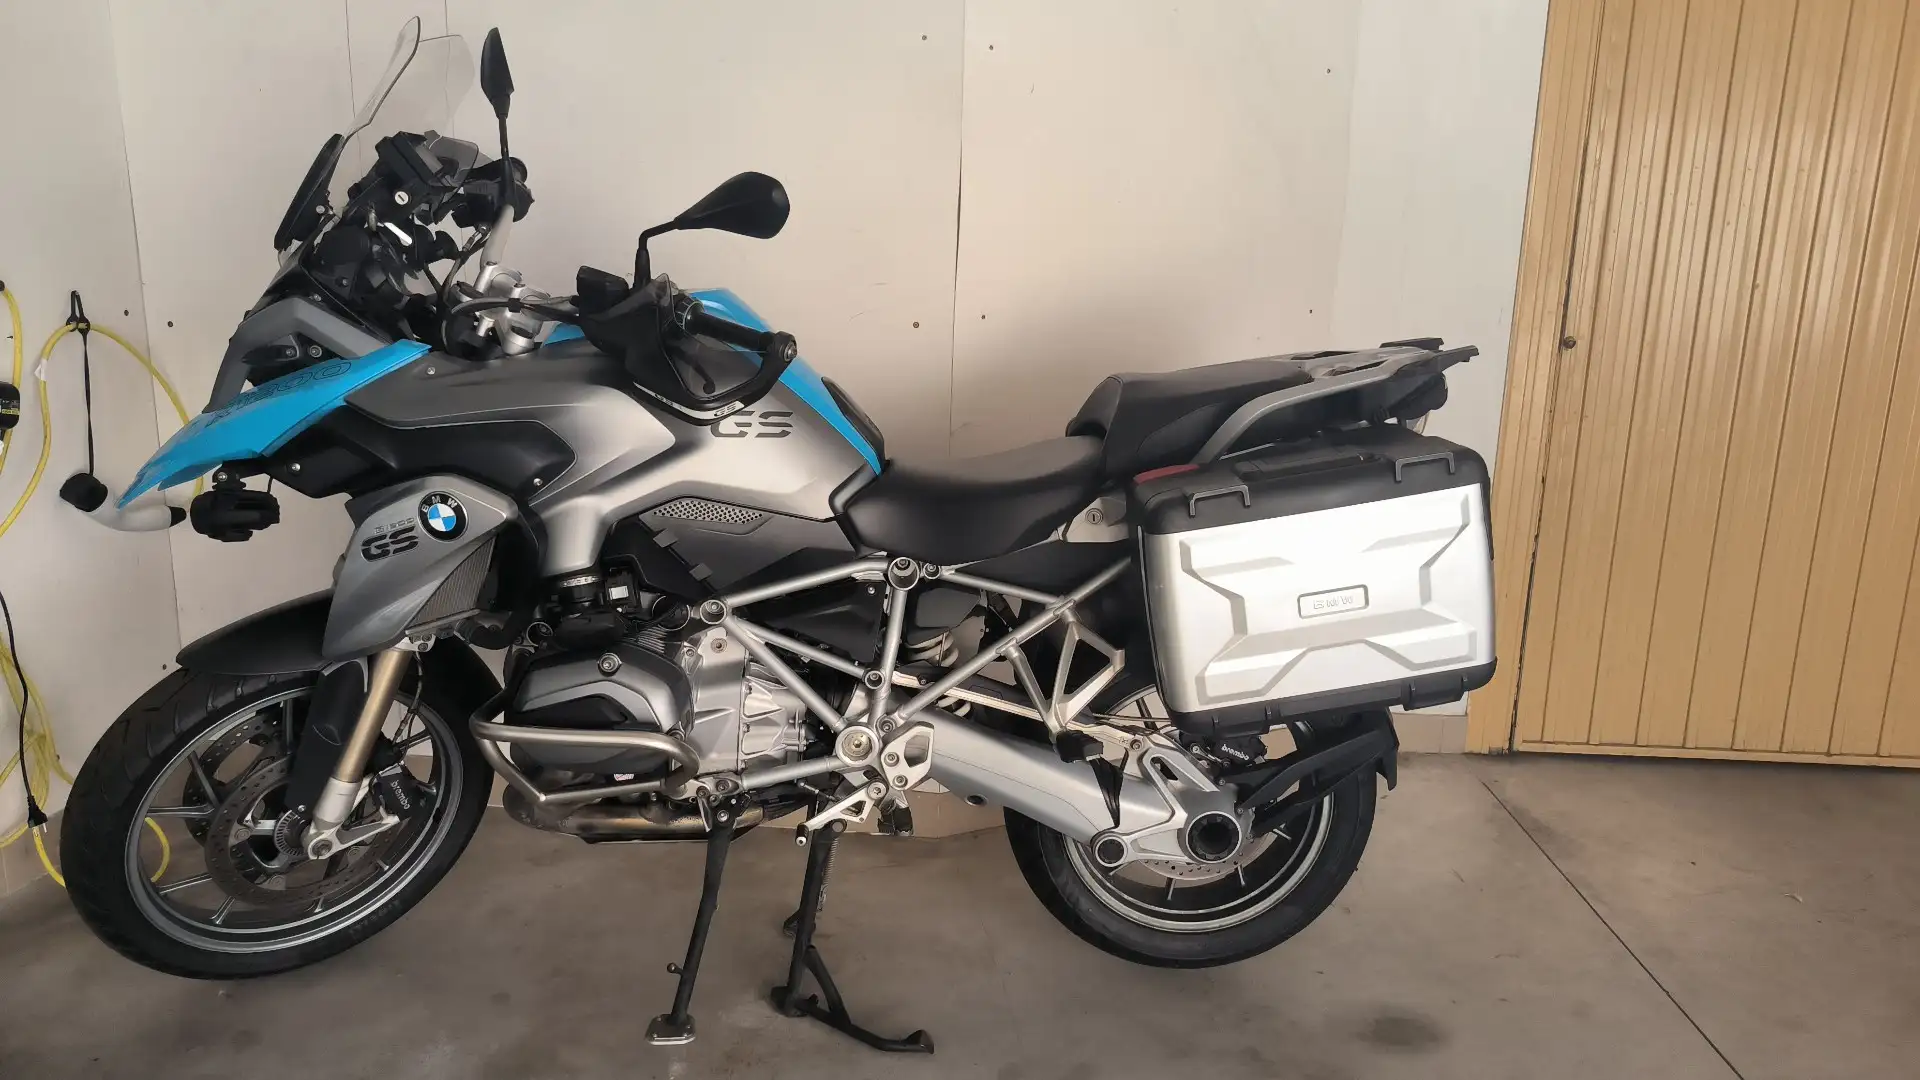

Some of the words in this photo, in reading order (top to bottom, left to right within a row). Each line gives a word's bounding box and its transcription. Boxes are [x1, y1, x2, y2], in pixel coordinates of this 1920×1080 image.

[710, 410, 793, 438] GS
[421, 495, 458, 513] BMW
[361, 525, 419, 562] GS
[1221, 744, 1250, 761] brembo
[391, 780, 411, 810] brembo
